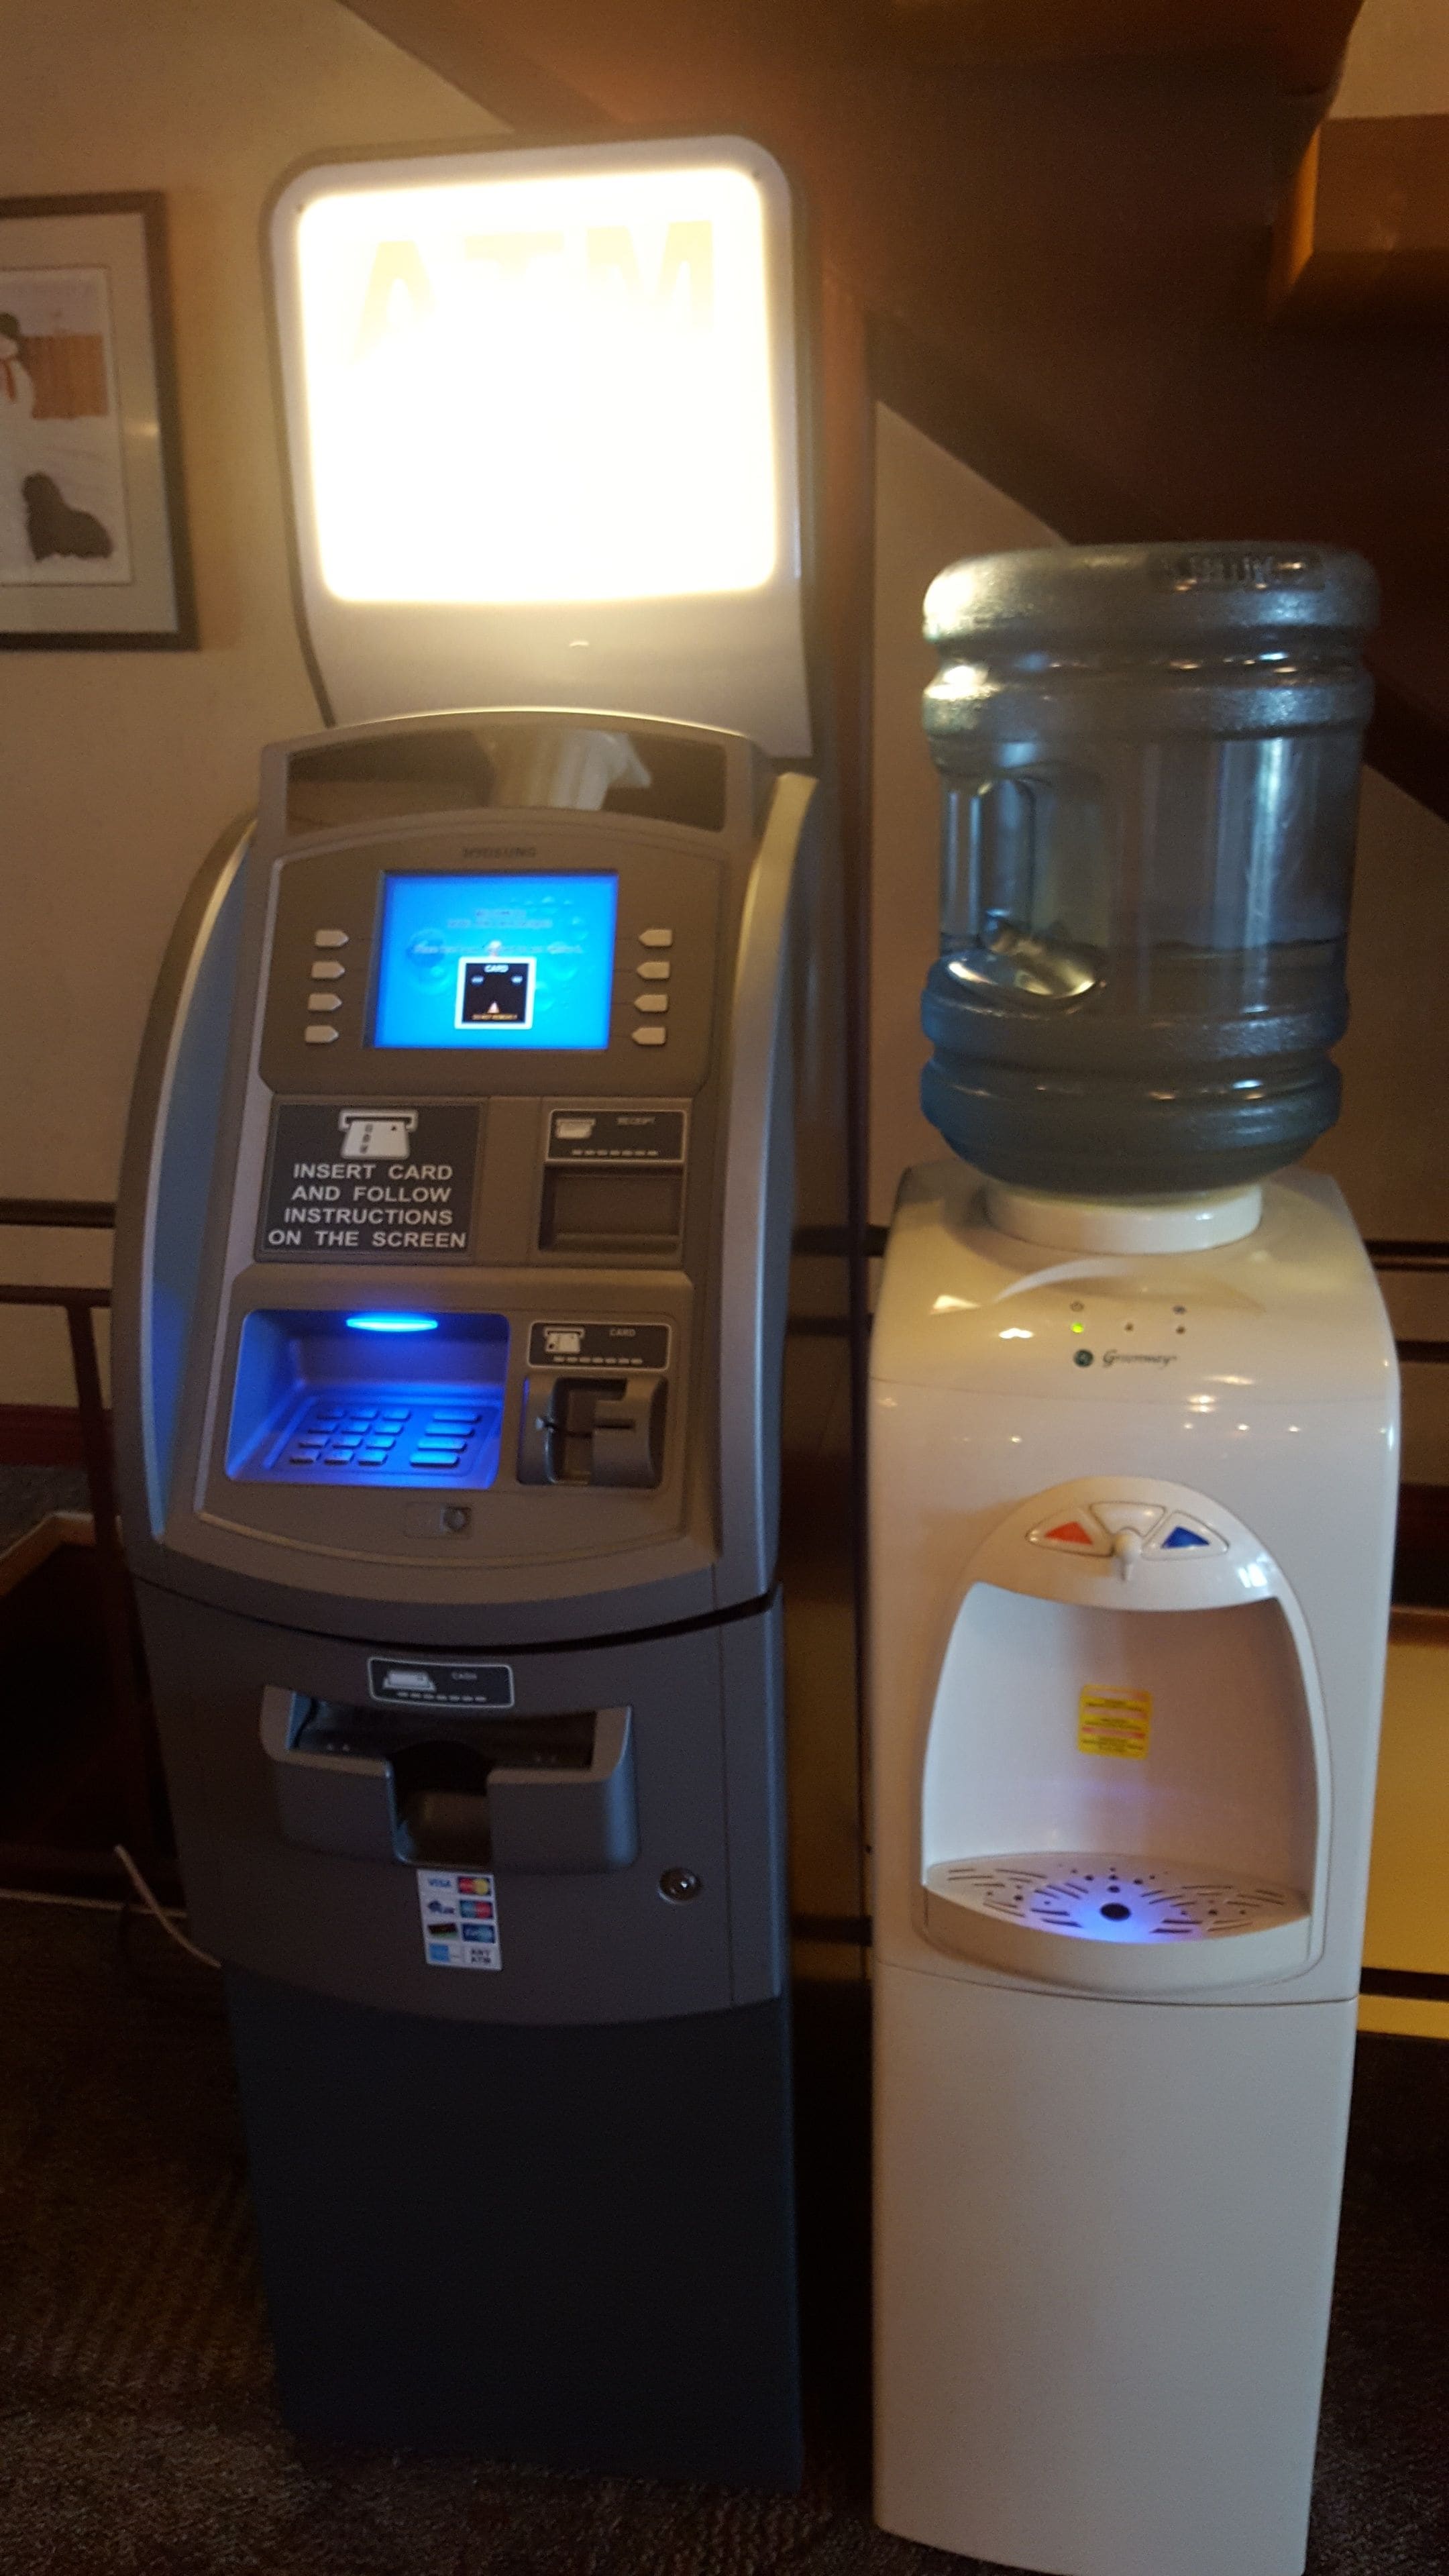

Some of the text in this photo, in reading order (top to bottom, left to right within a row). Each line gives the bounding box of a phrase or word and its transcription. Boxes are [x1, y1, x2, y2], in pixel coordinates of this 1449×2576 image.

[293, 1163, 453, 1181] INSERT CARD
[290, 1185, 451, 1203] AND FOLLOW
[284, 1208, 453, 1225] INSTRUCTIONS
[268, 1230, 466, 1248] ON THE SCREEN
